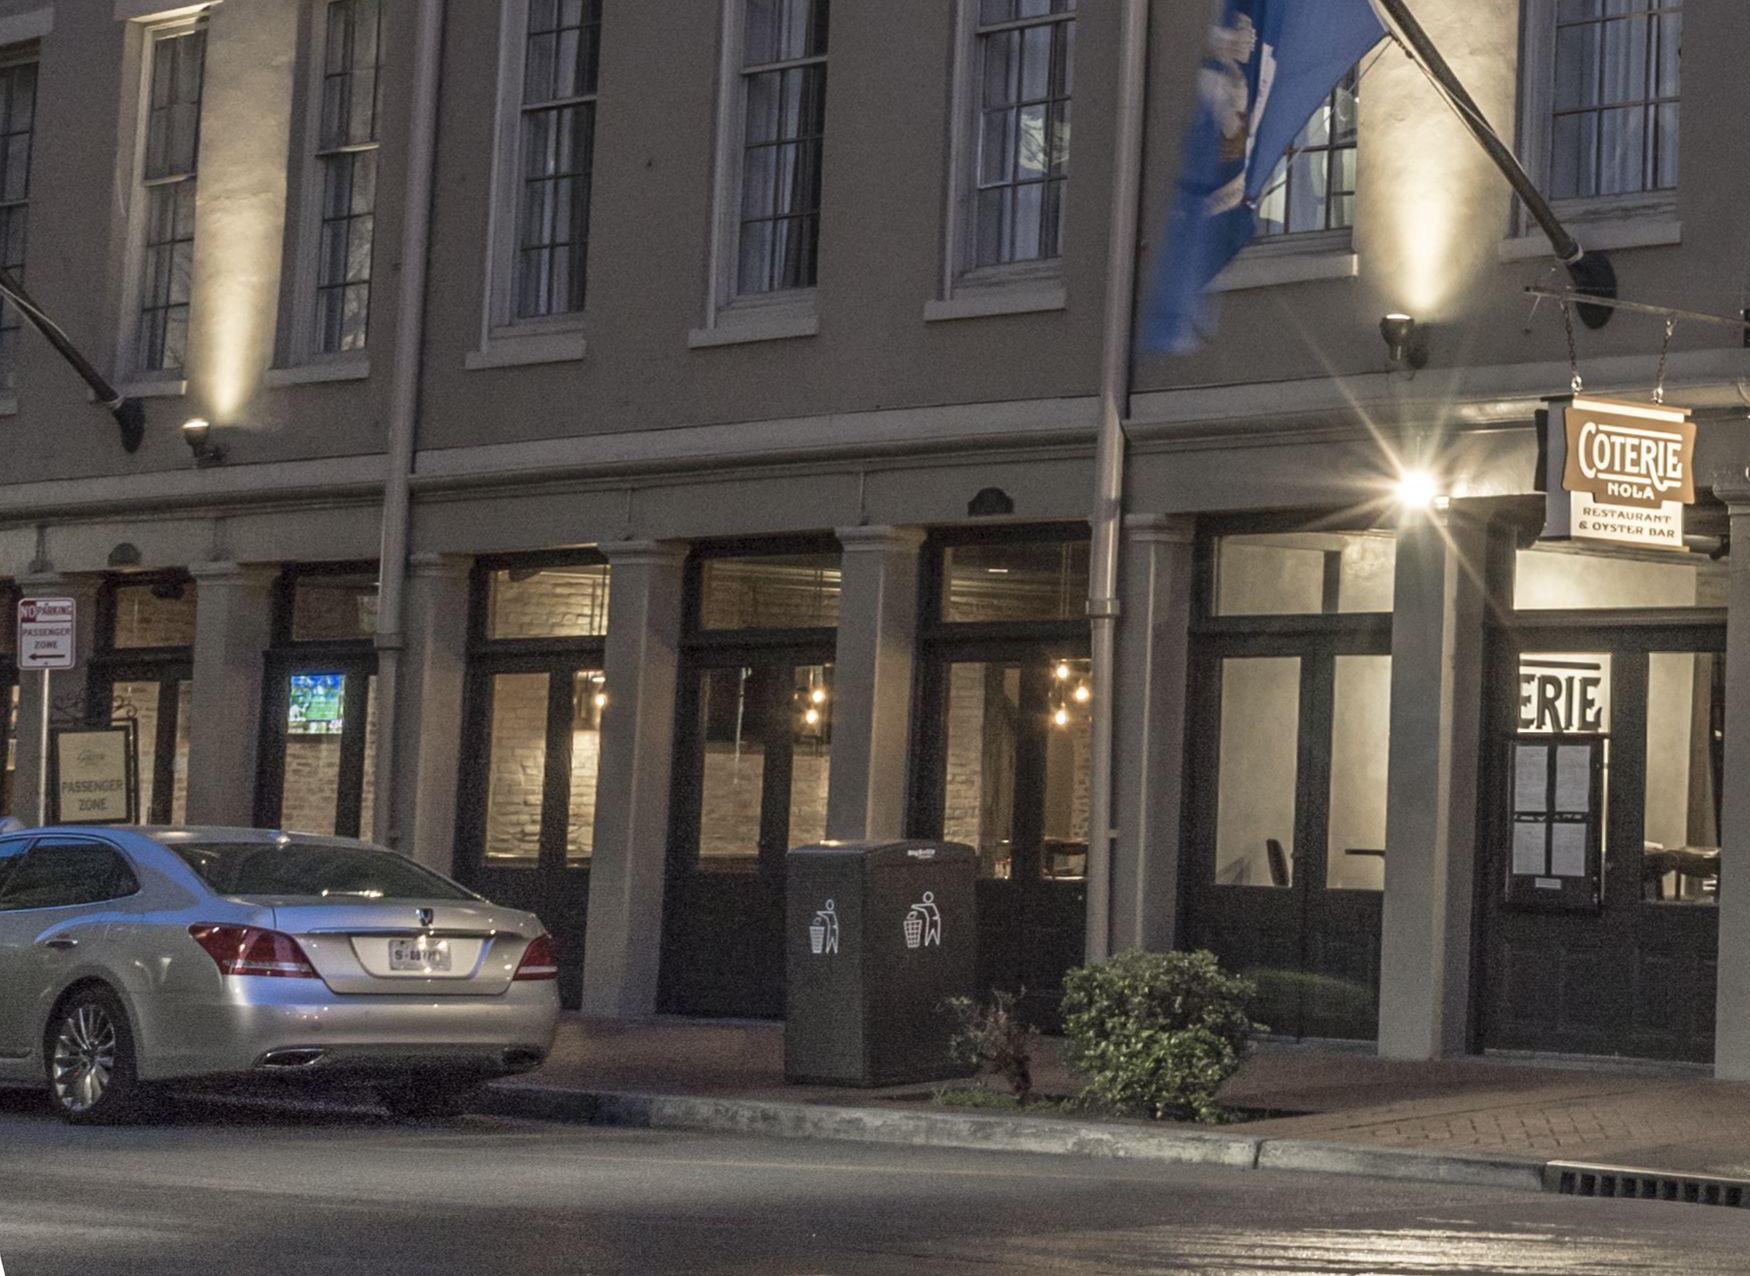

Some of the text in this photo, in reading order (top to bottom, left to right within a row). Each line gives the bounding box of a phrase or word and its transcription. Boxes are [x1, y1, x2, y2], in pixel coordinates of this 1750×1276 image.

[1578, 422, 1684, 491] COTERIE
[1607, 482, 1655, 500] NOLA
[1582, 507, 1672, 524] RESTAURANT
[1578, 521, 1676, 538] & OYSTER BAR
[21, 605, 72, 618] NO PARKING
[23, 628, 71, 637] PASSENGER
[34, 640, 58, 649] ZONE
[62, 779, 123, 792] PASSENGER
[79, 798, 108, 811] ZONE
